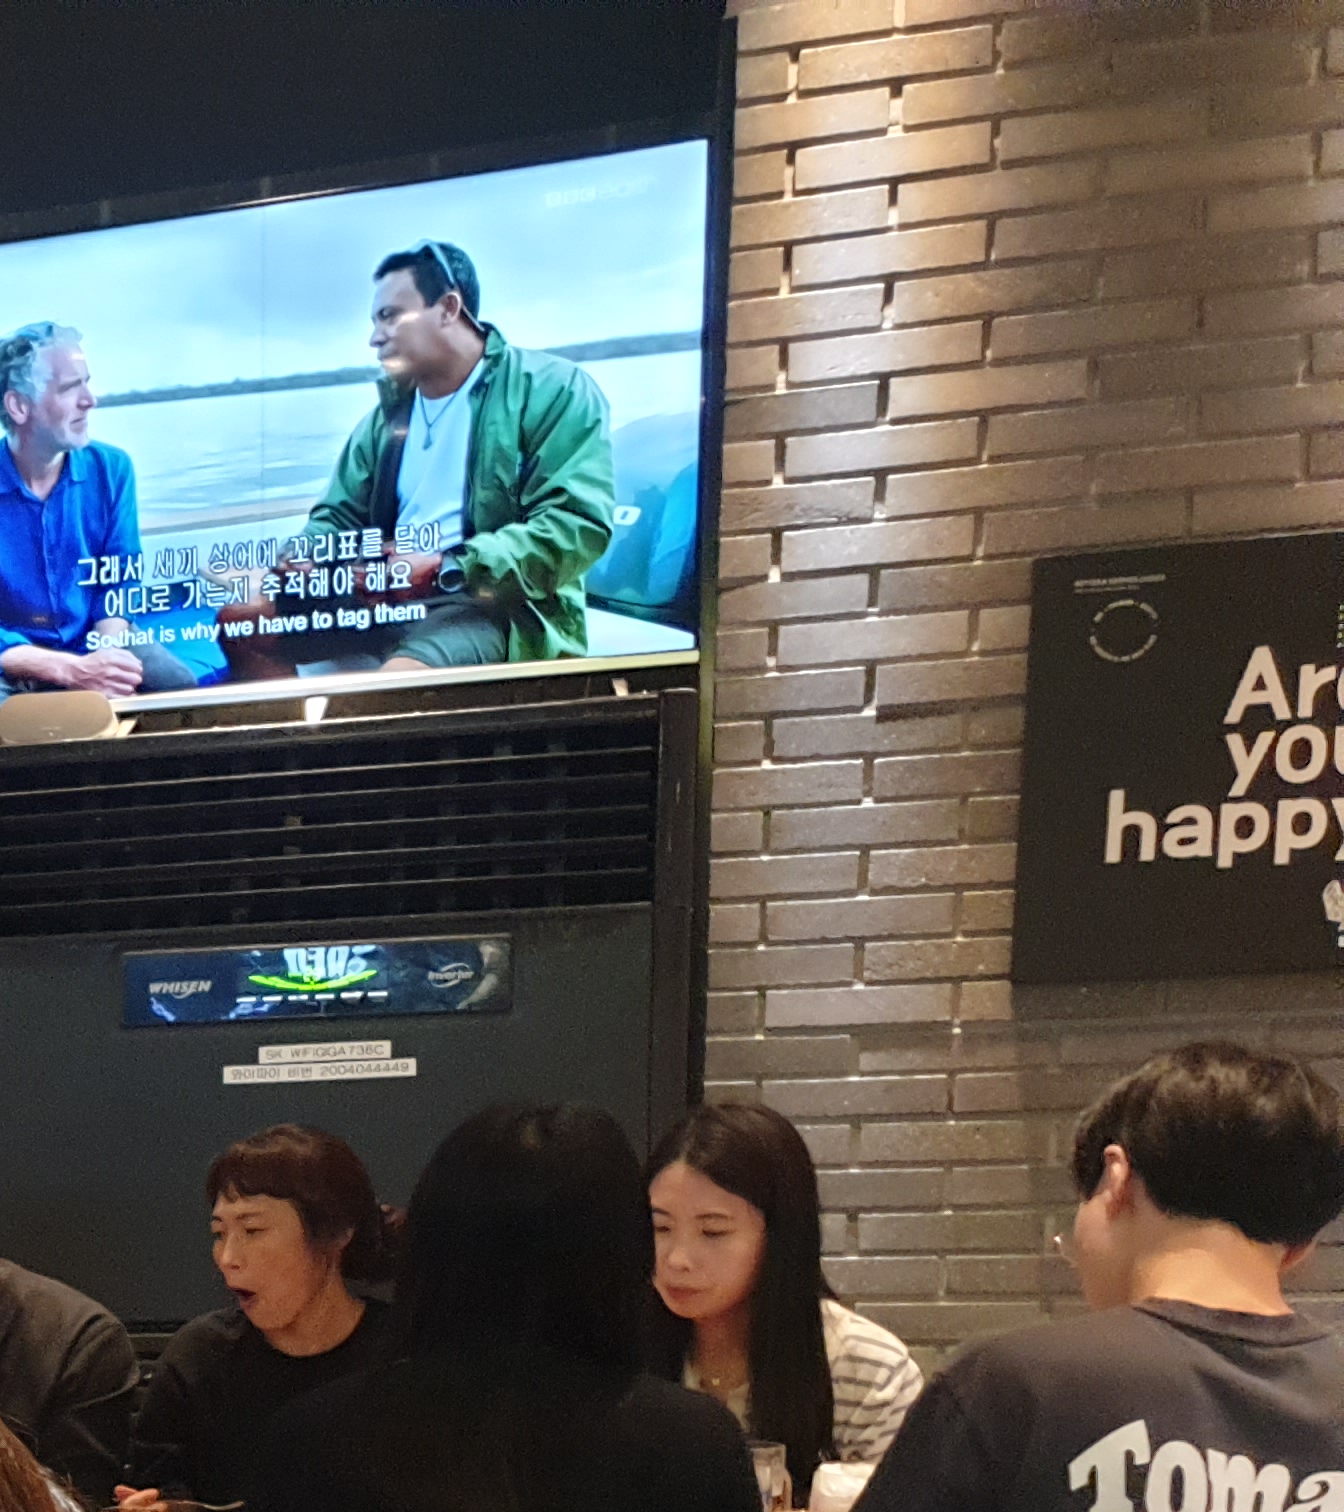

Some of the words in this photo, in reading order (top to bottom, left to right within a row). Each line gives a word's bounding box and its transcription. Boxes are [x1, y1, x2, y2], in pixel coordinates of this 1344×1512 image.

[78, 553, 143, 586] 그래서
[153, 546, 198, 578] 새끼
[209, 537, 277, 573] 상어에
[289, 528, 383, 564] 꼬리표를
[395, 521, 440, 555] 달아
[104, 585, 171, 617] 어디로
[182, 576, 249, 609] 가는지
[262, 565, 354, 601] 추적해야
[365, 561, 412, 591] 해요
[86, 631, 115, 650] So
[119, 628, 153, 647] that
[159, 625, 175, 643] is
[181, 622, 220, 643] why
[224, 620, 254, 637] we
[259, 615, 308, 635] have
[312, 610, 333, 628] to
[337, 608, 370, 630] tag
[375, 603, 426, 624] them
[1223, 645, 1344, 725] Ar
[1225, 723, 1344, 798] yo
[149, 980, 212, 997] WHISEN
[230, 1068, 281, 1081] 와이파이
